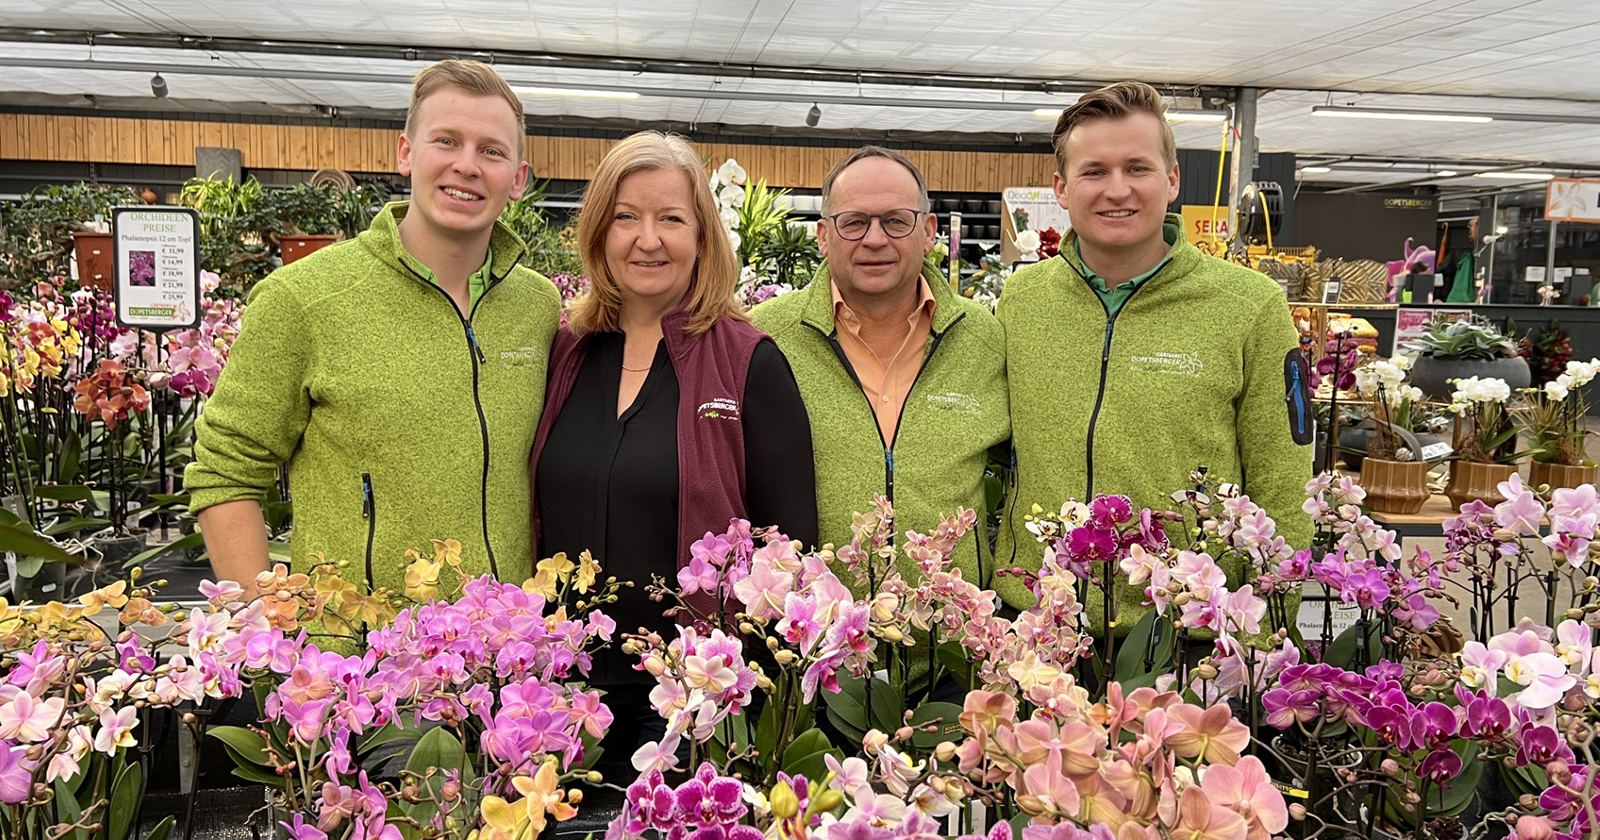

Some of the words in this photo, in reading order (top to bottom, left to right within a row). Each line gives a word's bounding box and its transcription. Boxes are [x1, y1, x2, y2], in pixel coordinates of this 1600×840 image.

[1384, 198, 1433, 207] DOPETSBERGER
[130, 213, 189, 223] ORCHIDEEN
[143, 223, 177, 233] PREISE
[177, 235, 192, 243] Topf
[130, 308, 173, 316] DOPETSBERGER
[1131, 355, 1182, 366] DOPETSBERGER
[697, 402, 737, 414] OPETSBERGER
